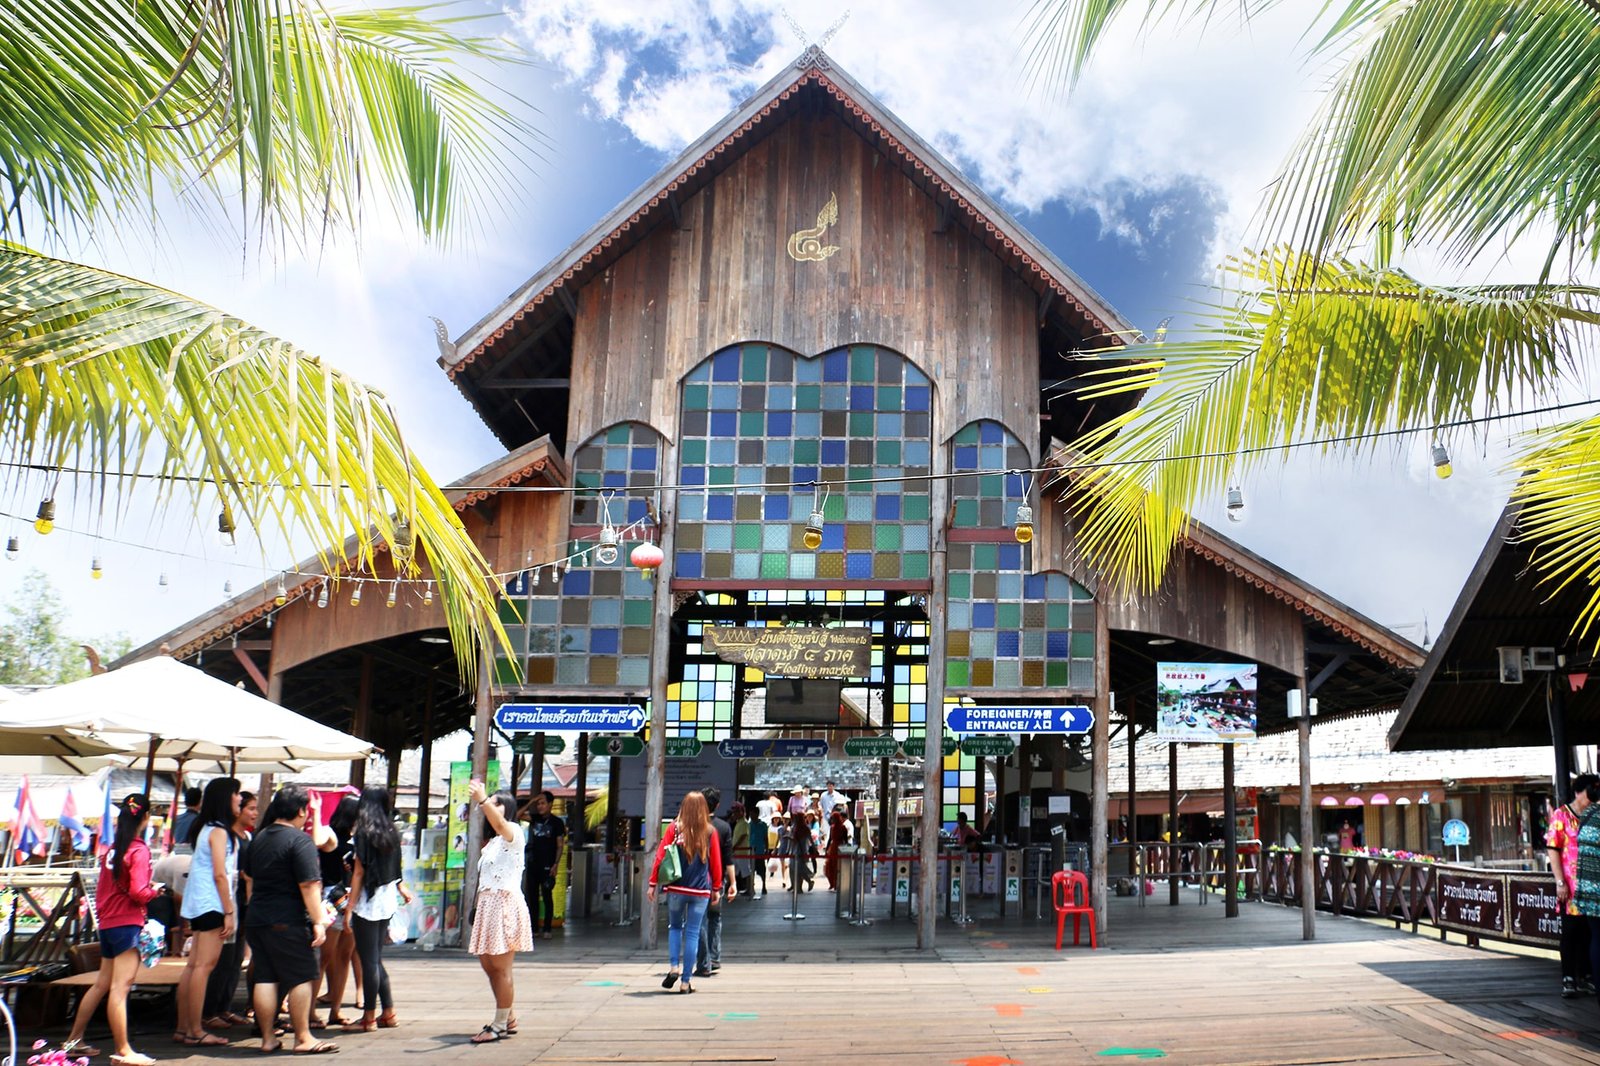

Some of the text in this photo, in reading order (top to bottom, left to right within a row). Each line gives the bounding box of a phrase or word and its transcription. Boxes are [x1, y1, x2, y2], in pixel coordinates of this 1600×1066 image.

[830, 635, 859, 644] Welcome
[860, 636, 867, 645] to
[744, 645, 802, 663] ตลาดน้ำ
[824, 649, 854, 662] ภาค
[770, 662, 856, 676] Floating market
[503, 707, 629, 724] เราคนไทยด้วยกันเข้าฟรี
[966, 720, 1029, 730] ENTRANCE/
[1517, 887, 1557, 909] เราคนไทย
